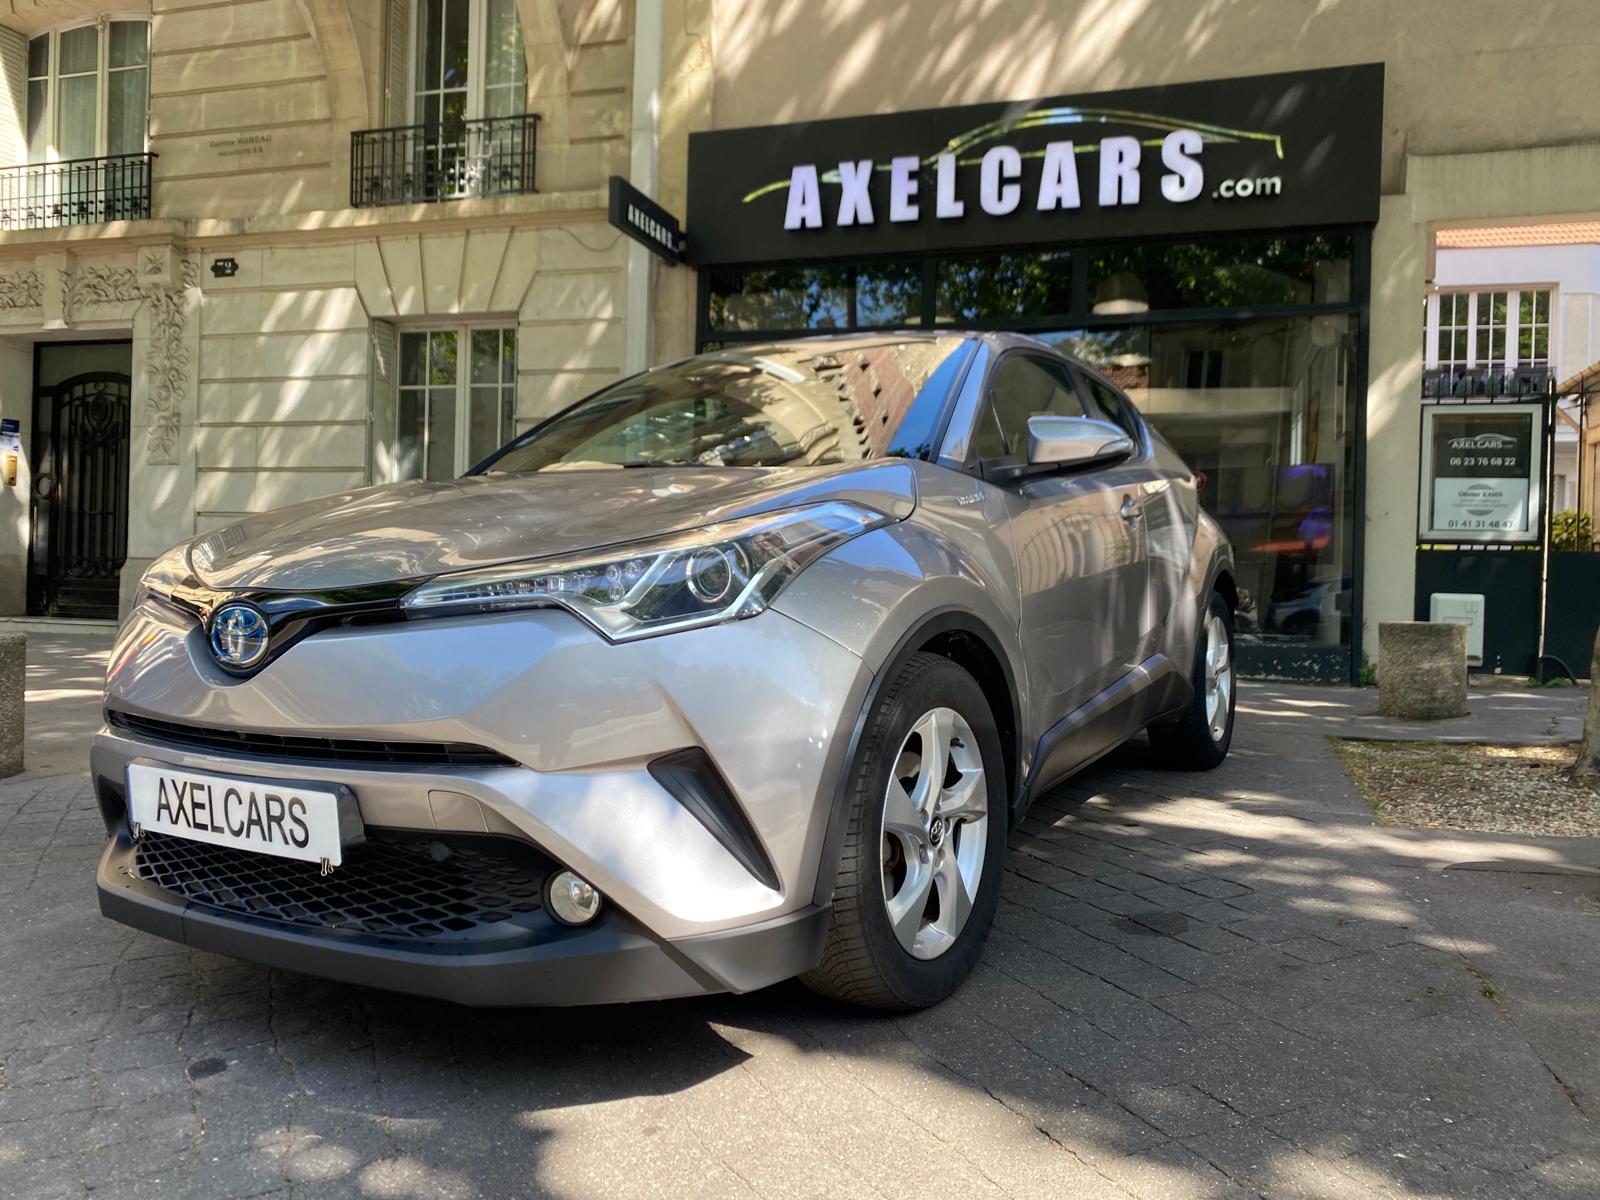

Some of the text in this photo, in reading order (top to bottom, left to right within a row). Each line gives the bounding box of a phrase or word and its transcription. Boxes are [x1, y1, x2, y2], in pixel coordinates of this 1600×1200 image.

[784, 130, 1204, 230] AXELCARS
[627, 203, 673, 249] AXELCARS
[1451, 439, 1503, 449] AXELCARS
[1463, 457, 1475, 466] 23
[1504, 457, 1516, 466] 22
[1448, 520, 1458, 528] 01
[1462, 520, 1472, 528] 41
[1475, 520, 1485, 528] 31
[157, 777, 310, 849] AXELCARS
